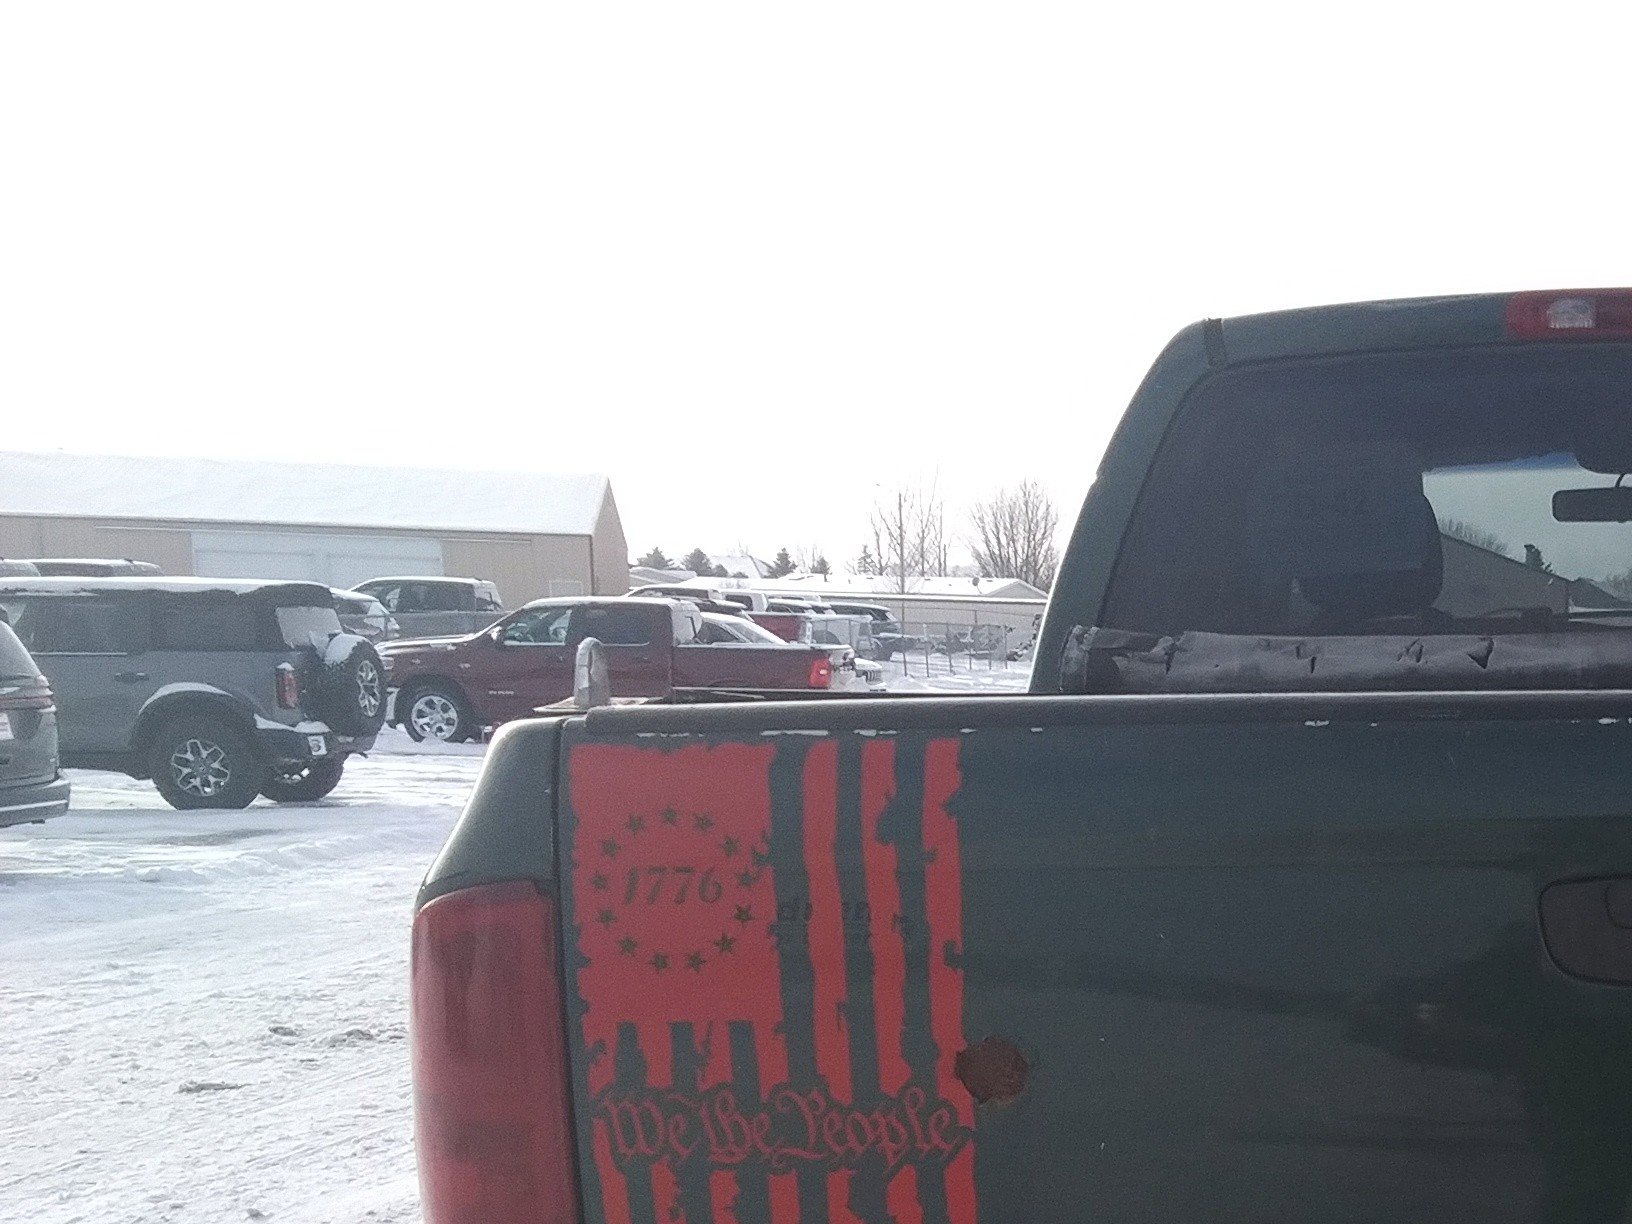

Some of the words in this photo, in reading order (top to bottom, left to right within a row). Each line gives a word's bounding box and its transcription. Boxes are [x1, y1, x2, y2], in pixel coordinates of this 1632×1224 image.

[623, 866, 723, 905] 1776
[602, 1090, 698, 1162] We
[768, 1085, 962, 1168] People
